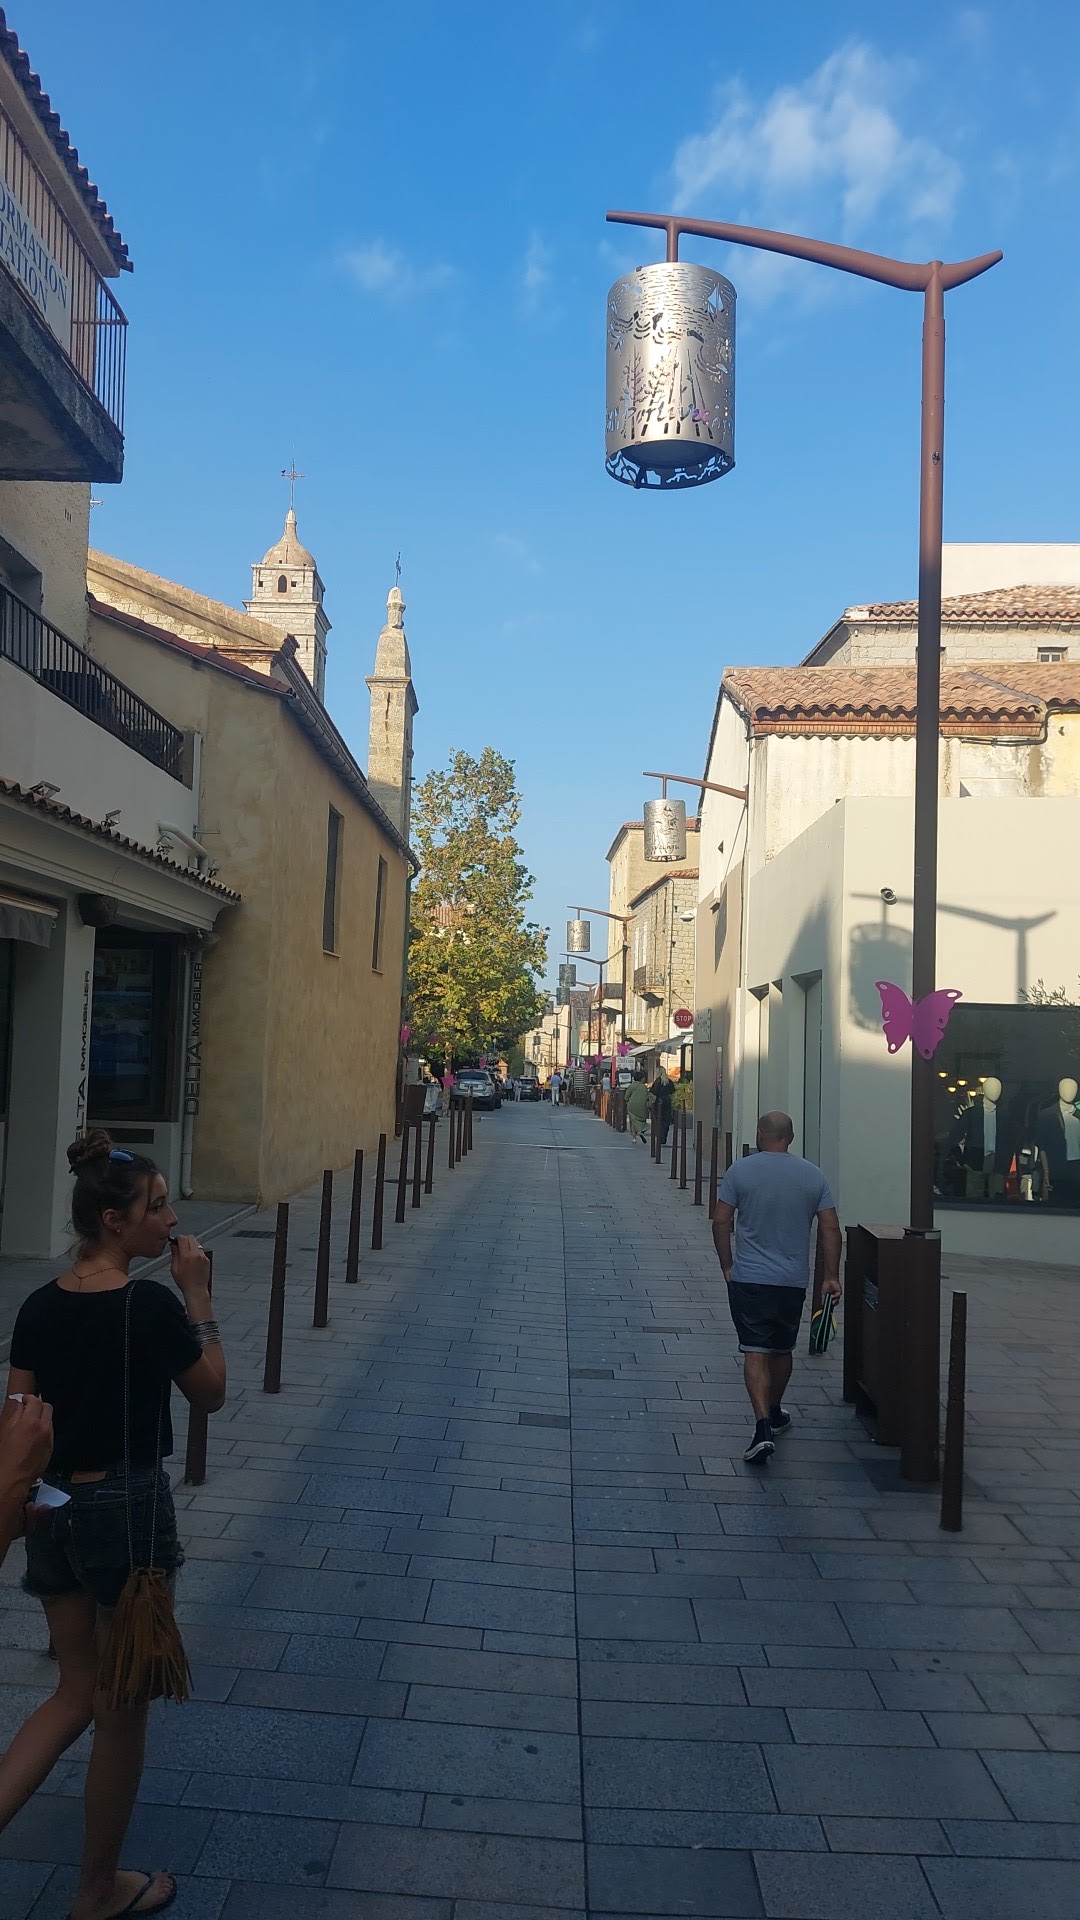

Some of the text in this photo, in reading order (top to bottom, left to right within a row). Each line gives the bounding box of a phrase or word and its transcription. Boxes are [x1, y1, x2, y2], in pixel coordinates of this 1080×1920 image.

[80, 970, 90, 1071] IMMOBILIER
[184, 962, 203, 1116] DELTA IMMOBILIER
